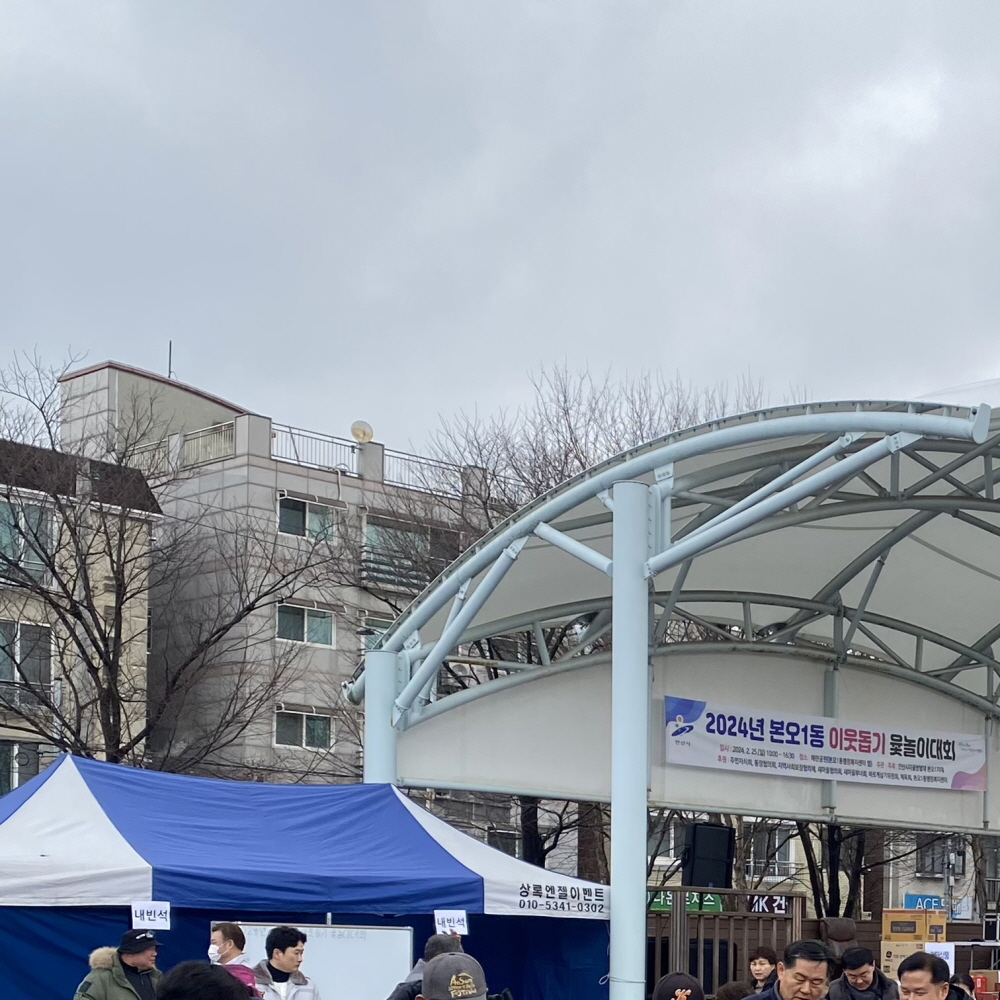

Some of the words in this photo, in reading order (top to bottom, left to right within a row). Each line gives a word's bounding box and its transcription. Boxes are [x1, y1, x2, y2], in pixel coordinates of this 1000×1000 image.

[706, 712, 765, 742] 2024년
[769, 719, 825, 749] 본오1동
[829, 726, 886, 756] 이웃돕기
[890, 733, 956, 762] 윷놀이대회
[519, 883, 605, 902] 상록엔젤이벤트
[518, 899, 604, 914] 010-5341-0302
[915, 897, 939, 910] ACE
[134, 909, 168, 923] 내빈석
[436, 917, 466, 929] 내빈석
